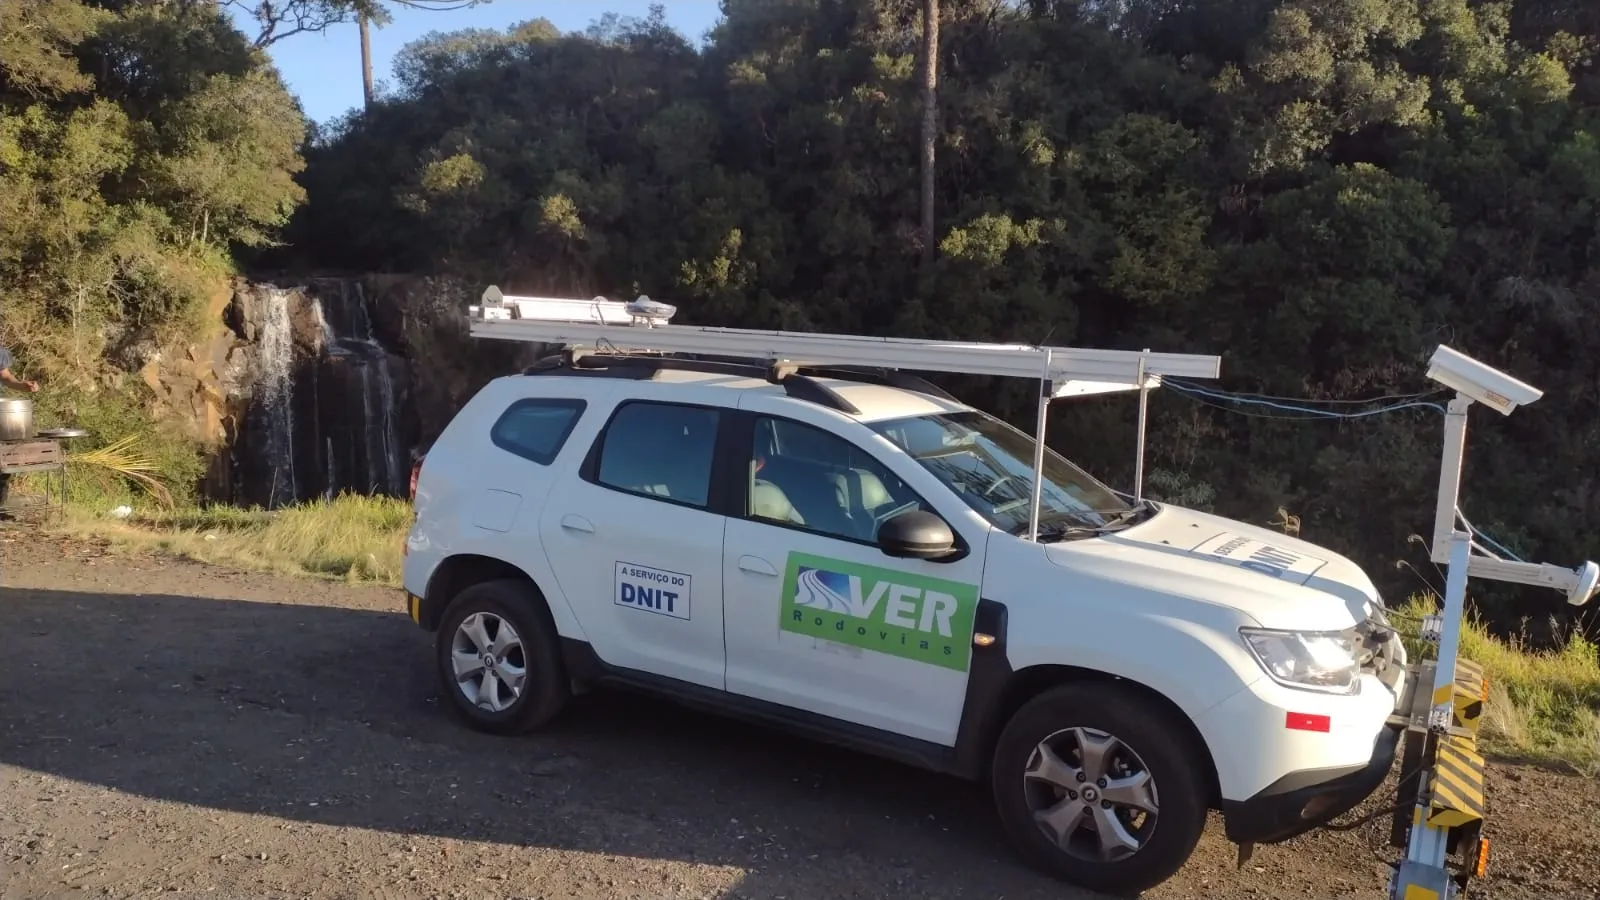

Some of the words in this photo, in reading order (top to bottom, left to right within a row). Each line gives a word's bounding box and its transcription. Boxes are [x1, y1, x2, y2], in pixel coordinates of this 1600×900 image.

[621, 567, 628, 575] A
[630, 568, 669, 584] SERVIÇO
[671, 576, 685, 586] DO
[621, 582, 679, 613] DNIT
[793, 610, 952, 656] Rodovias
